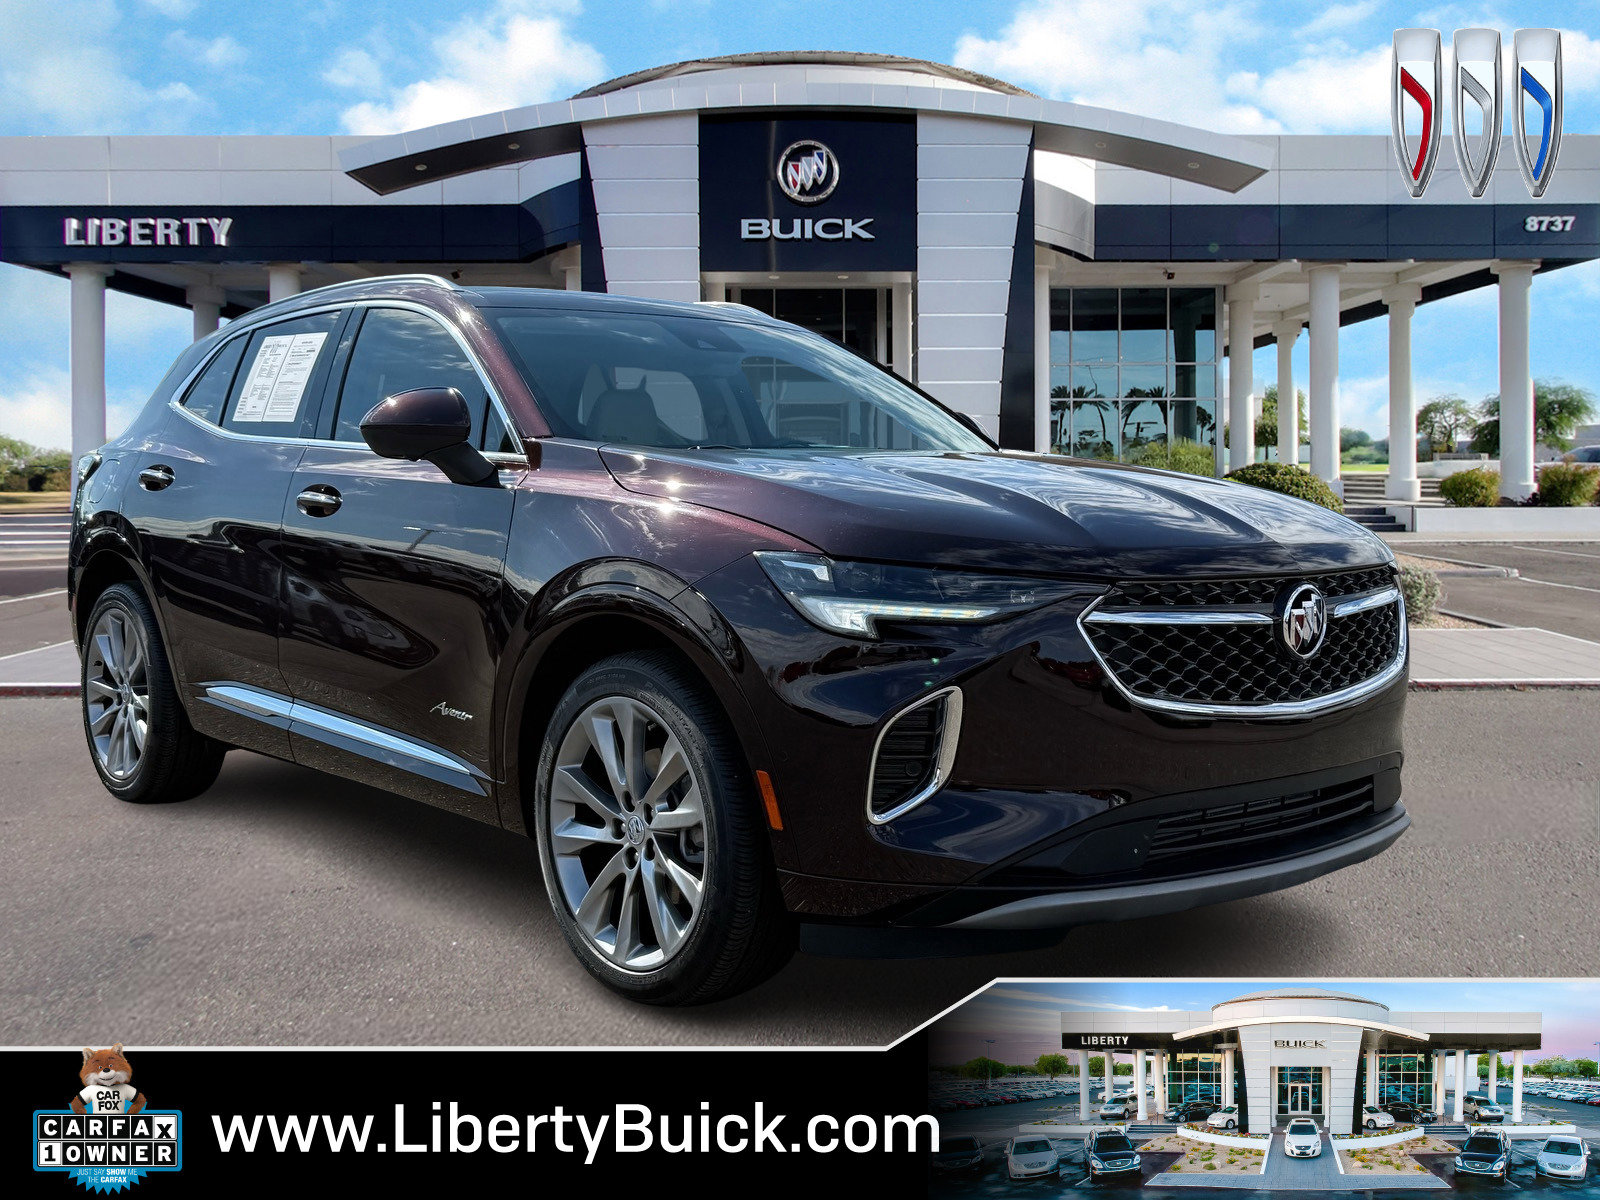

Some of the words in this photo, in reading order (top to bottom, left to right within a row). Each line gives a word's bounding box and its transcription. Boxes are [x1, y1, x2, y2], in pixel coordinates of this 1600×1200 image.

[64, 217, 233, 246] LIBERTY
[740, 218, 876, 240] BUICK
[1524, 215, 1576, 232] 8737
